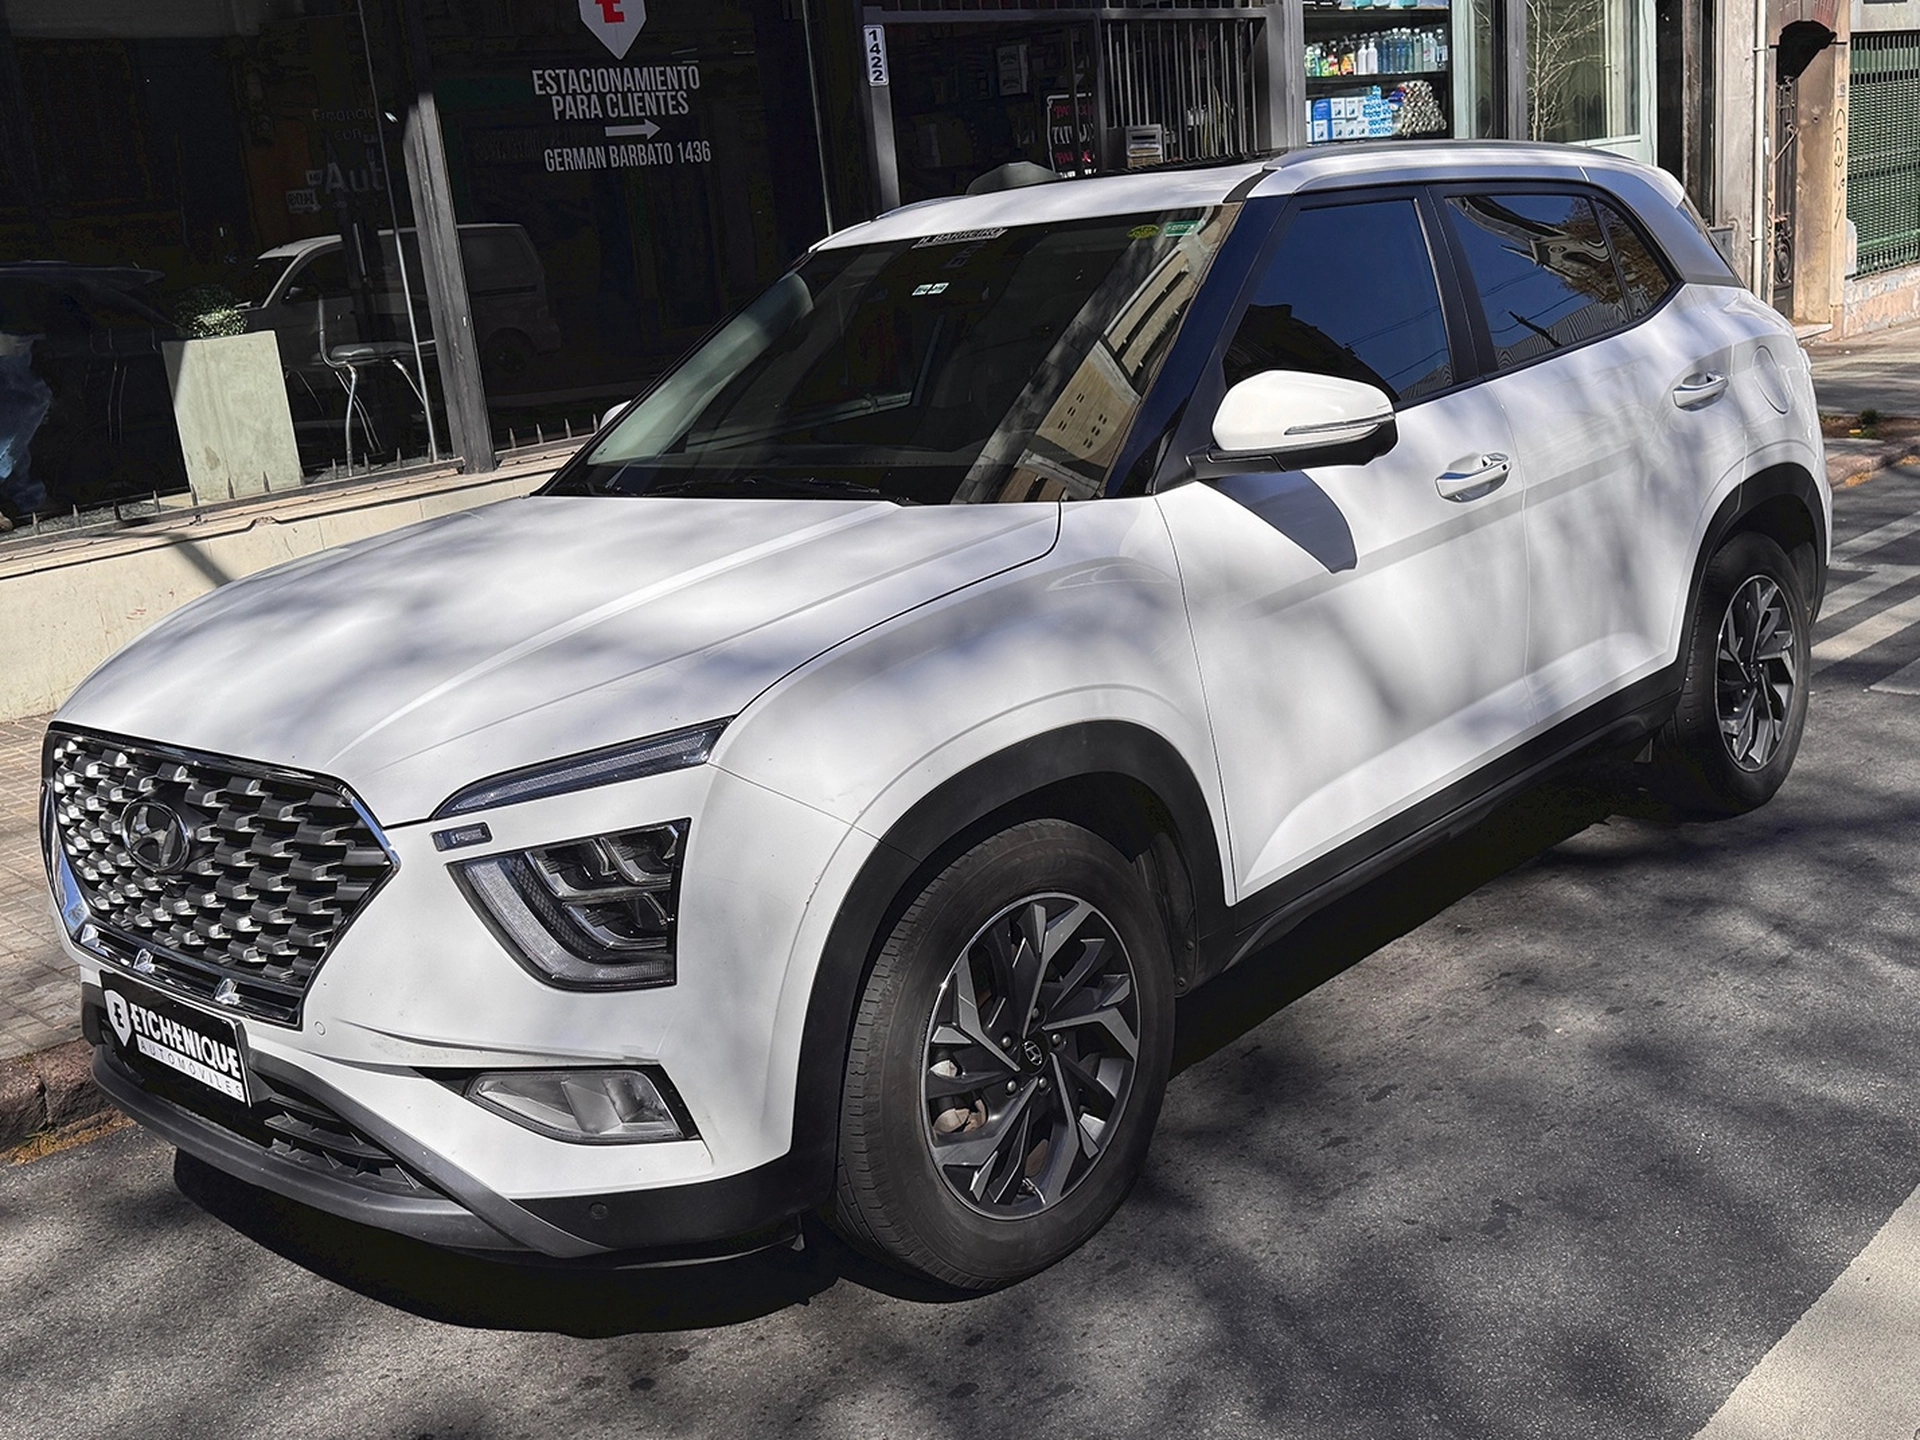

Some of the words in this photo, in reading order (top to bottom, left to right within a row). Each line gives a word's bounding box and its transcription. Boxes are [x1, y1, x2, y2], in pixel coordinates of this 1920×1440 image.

[869, 29, 884, 81] 1422
[532, 65, 701, 95] ESTACIONAMIENTO
[552, 93, 603, 120] PARA
[606, 91, 689, 118] CLIENTES
[544, 146, 607, 172] GERMAN
[609, 142, 673, 168] BARBATO
[677, 140, 711, 164] 1436
[130, 1003, 242, 1080] ETCHENIQUE
[140, 1042, 243, 1099] AUTOMOVILES
